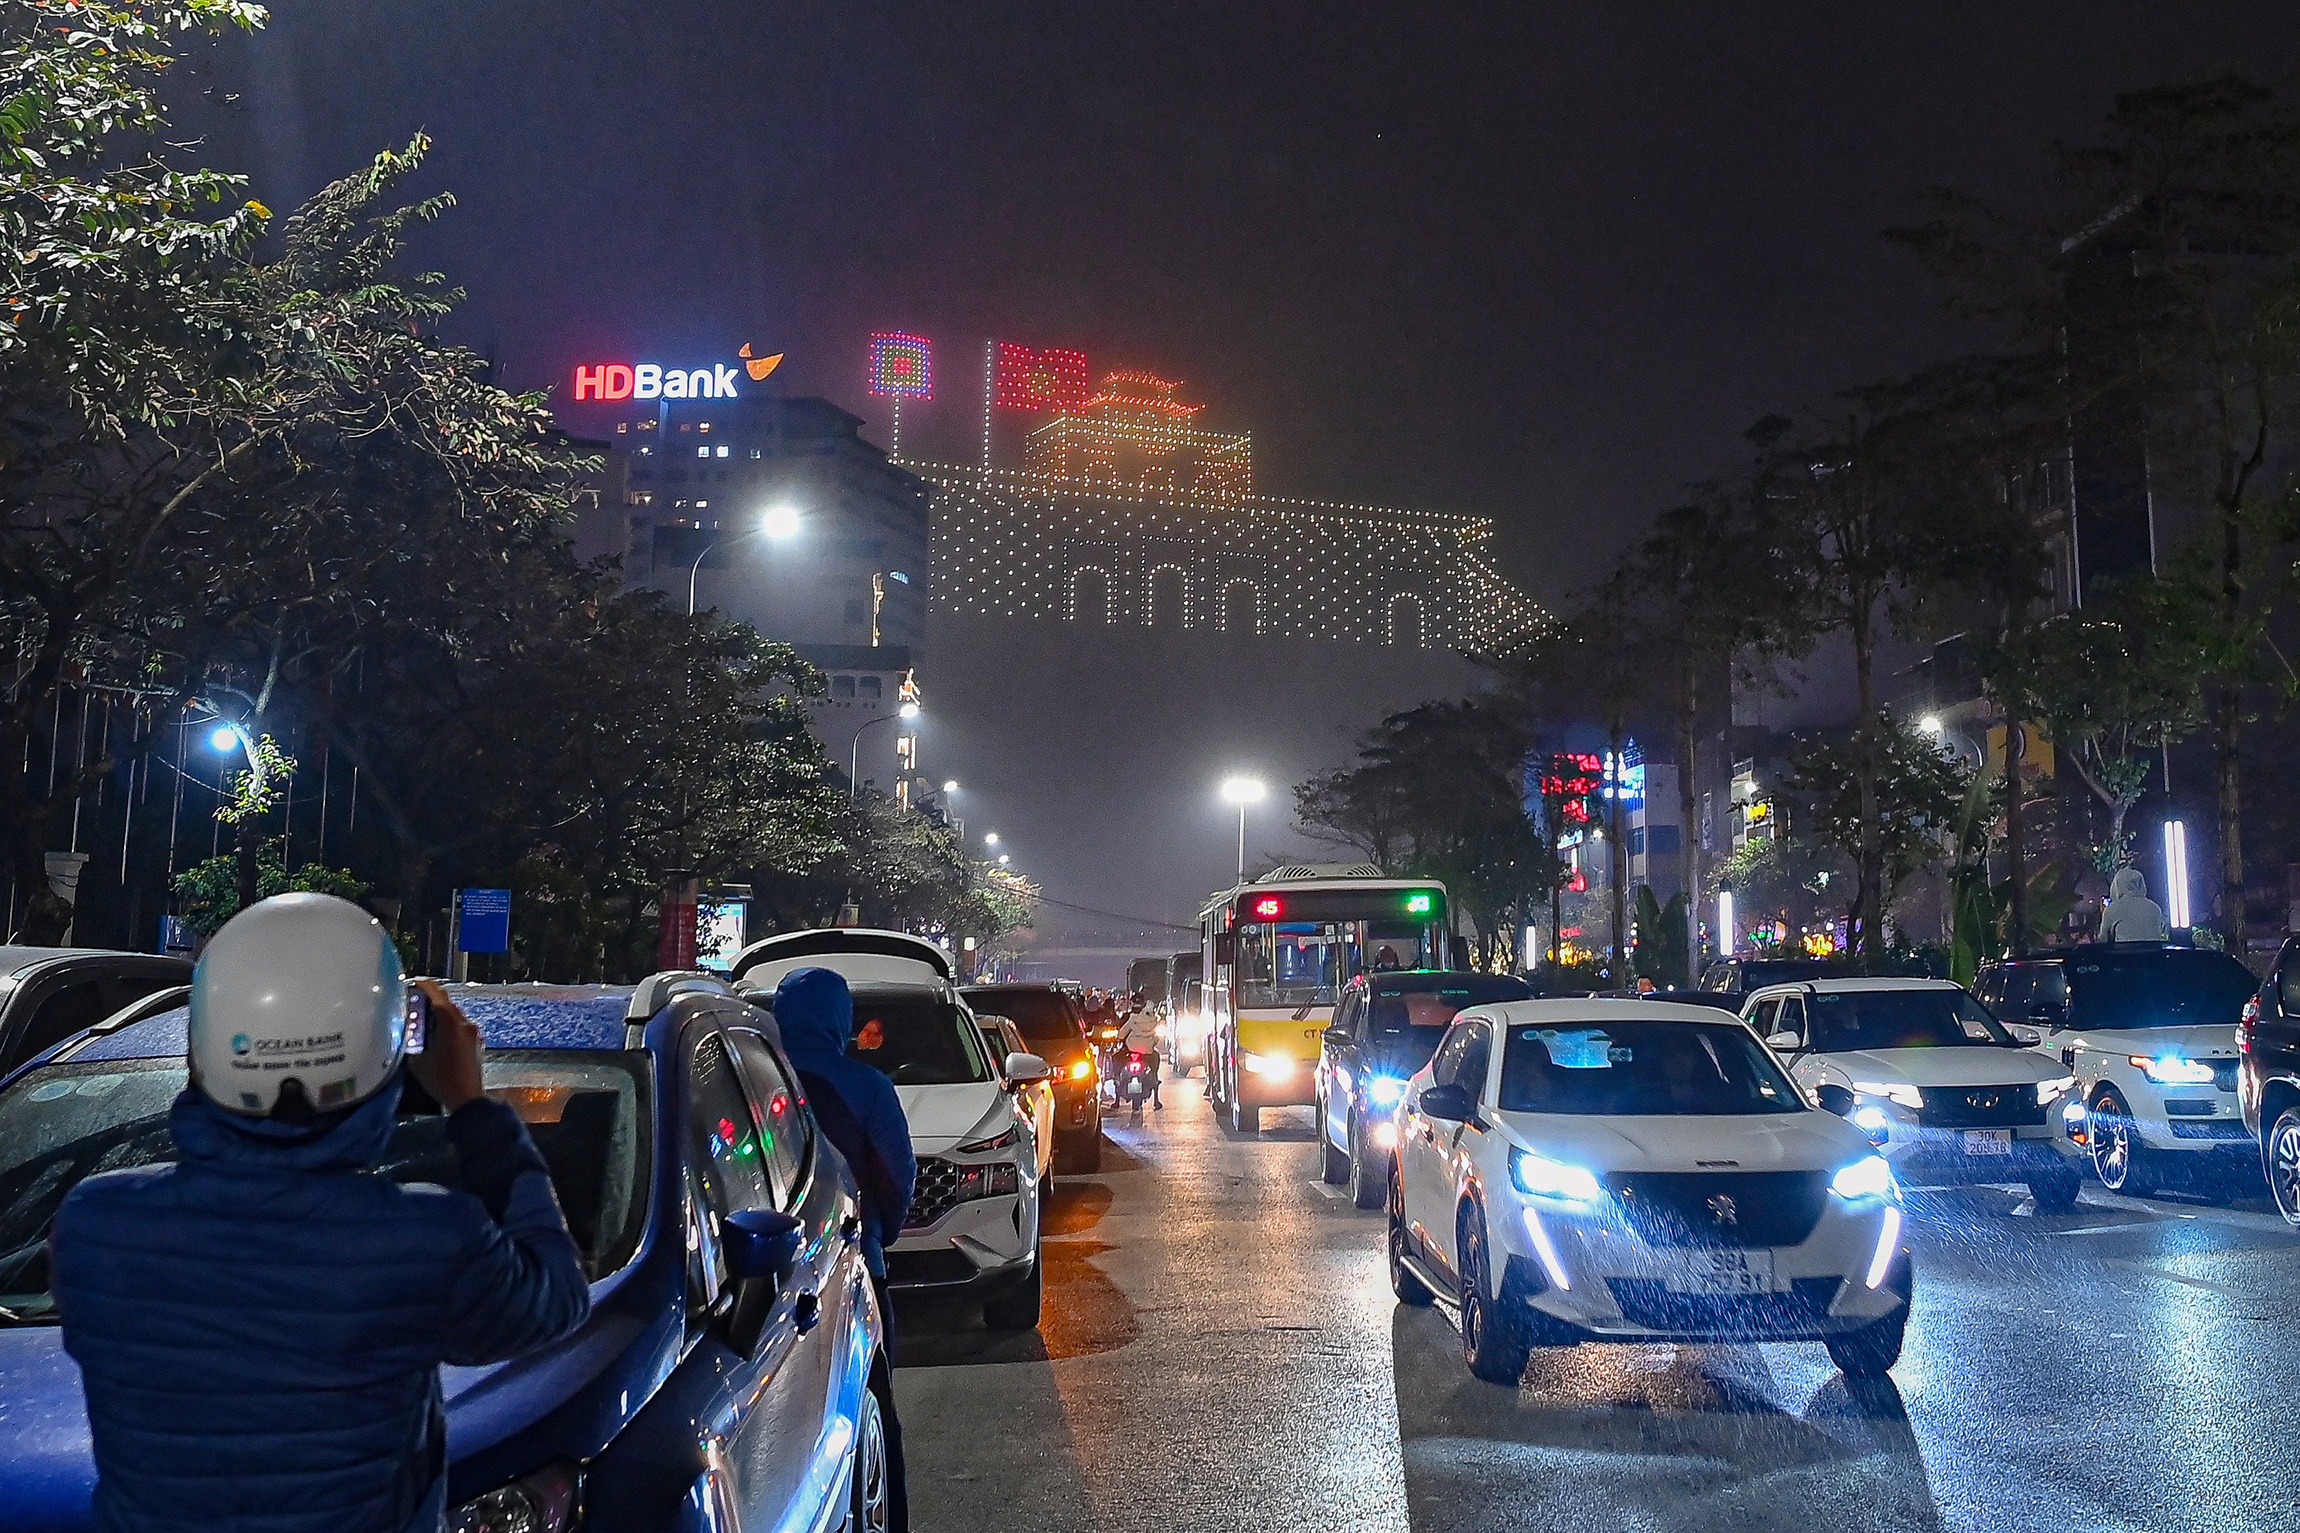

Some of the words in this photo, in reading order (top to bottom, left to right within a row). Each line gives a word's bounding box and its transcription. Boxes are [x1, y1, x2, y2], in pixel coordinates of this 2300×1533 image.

[575, 363, 739, 400] HDBank
[1257, 900, 1278, 916] 45
[254, 1038, 304, 1050] OCEAN
